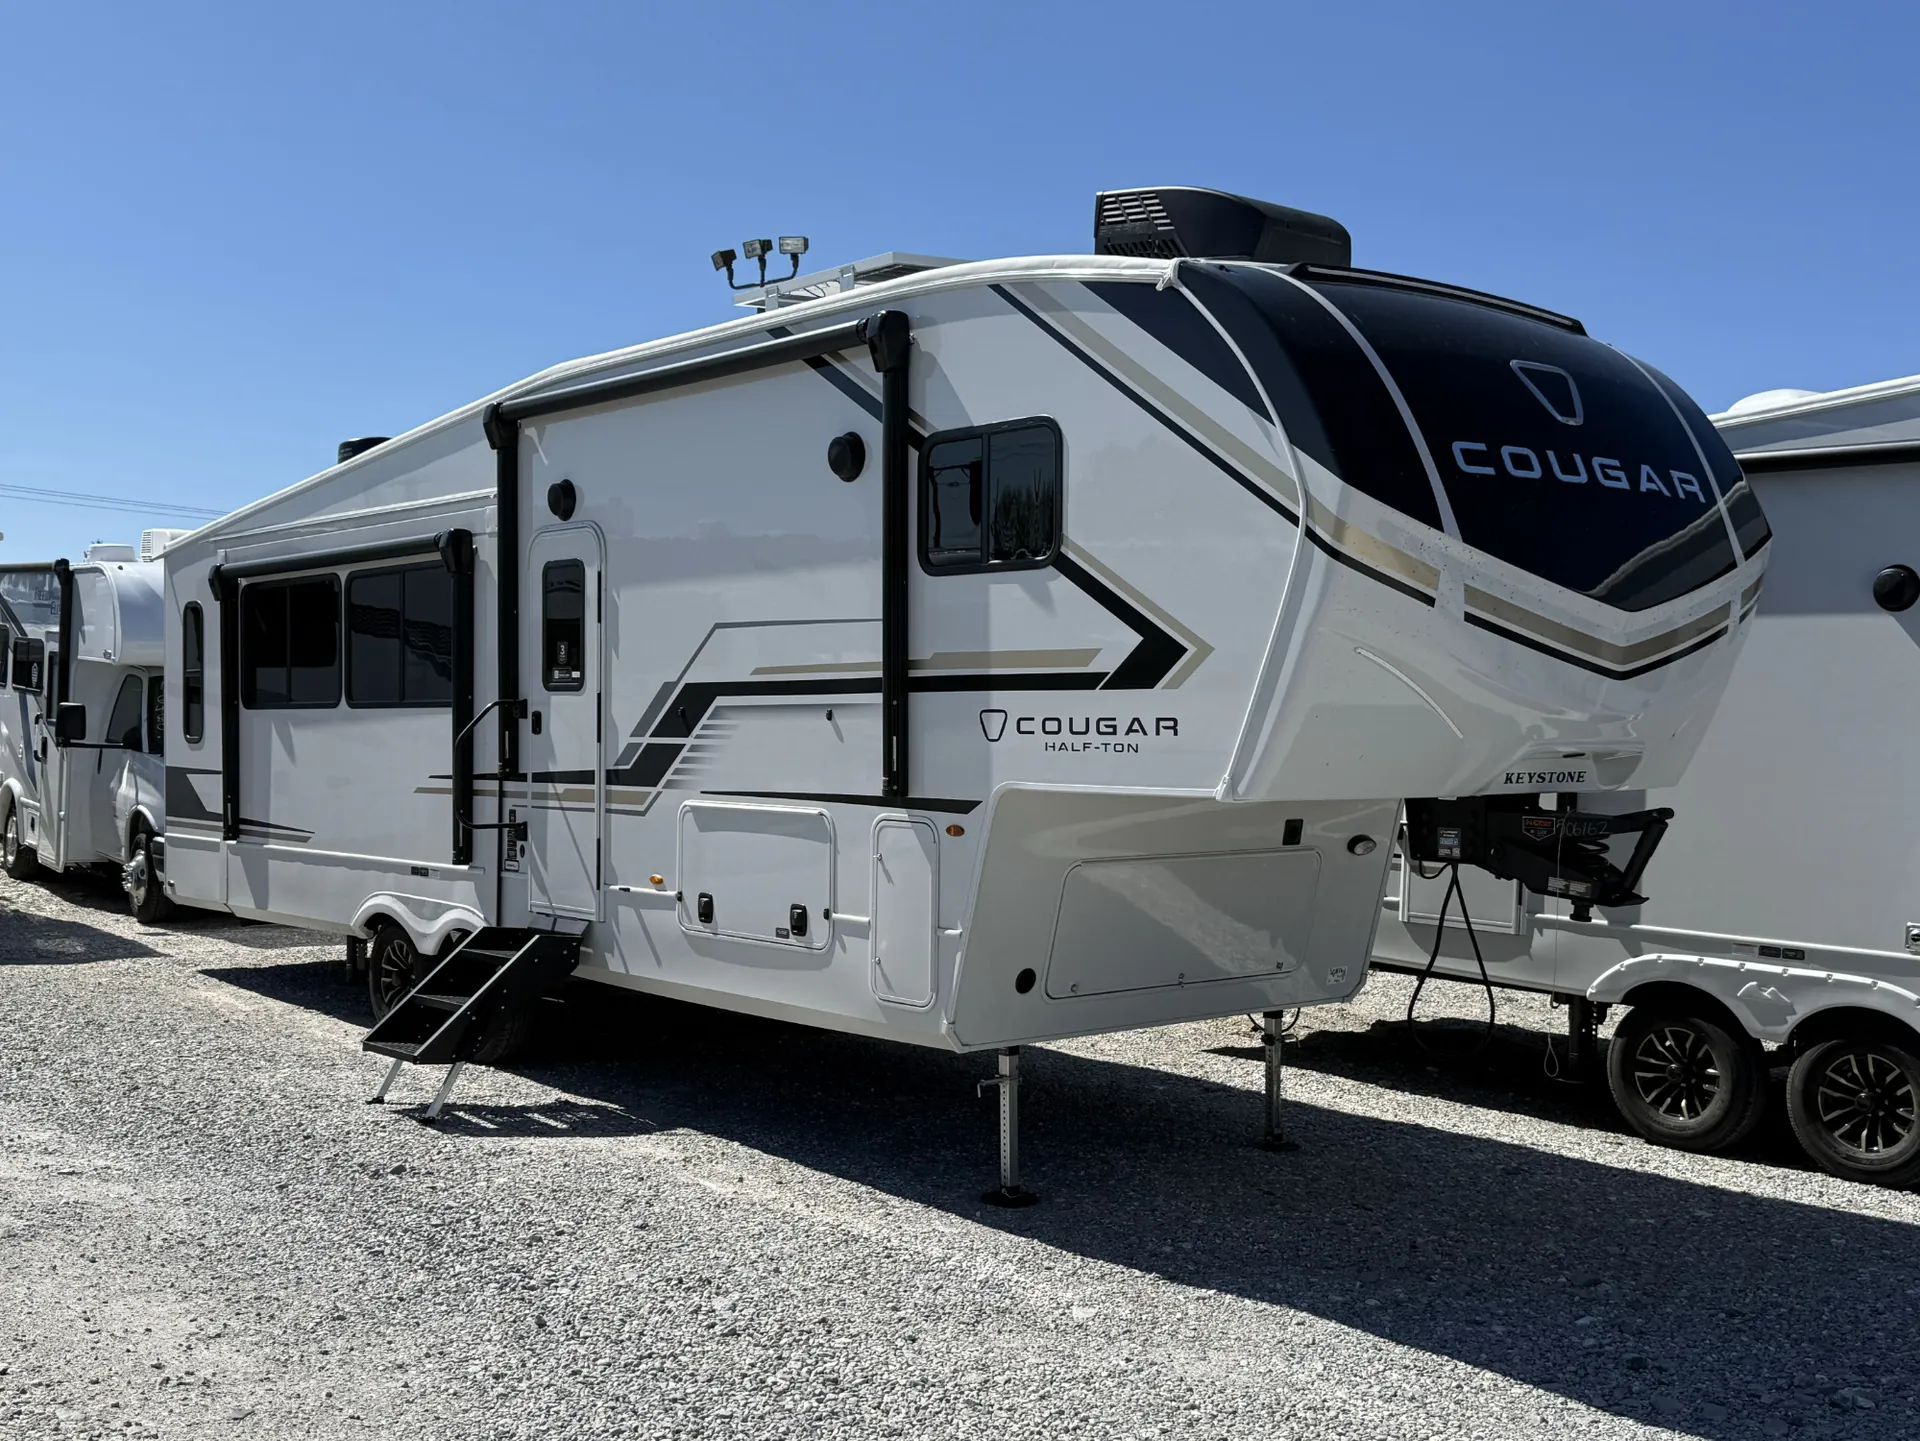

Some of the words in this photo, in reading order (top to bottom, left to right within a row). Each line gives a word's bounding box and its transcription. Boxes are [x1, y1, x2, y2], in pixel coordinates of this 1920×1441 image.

[1452, 441, 1706, 503] COUGAR
[1016, 717, 1179, 736] COUGAR
[1045, 742, 1139, 753] HALF-TON
[1503, 771, 1587, 785] KEYSTONE
